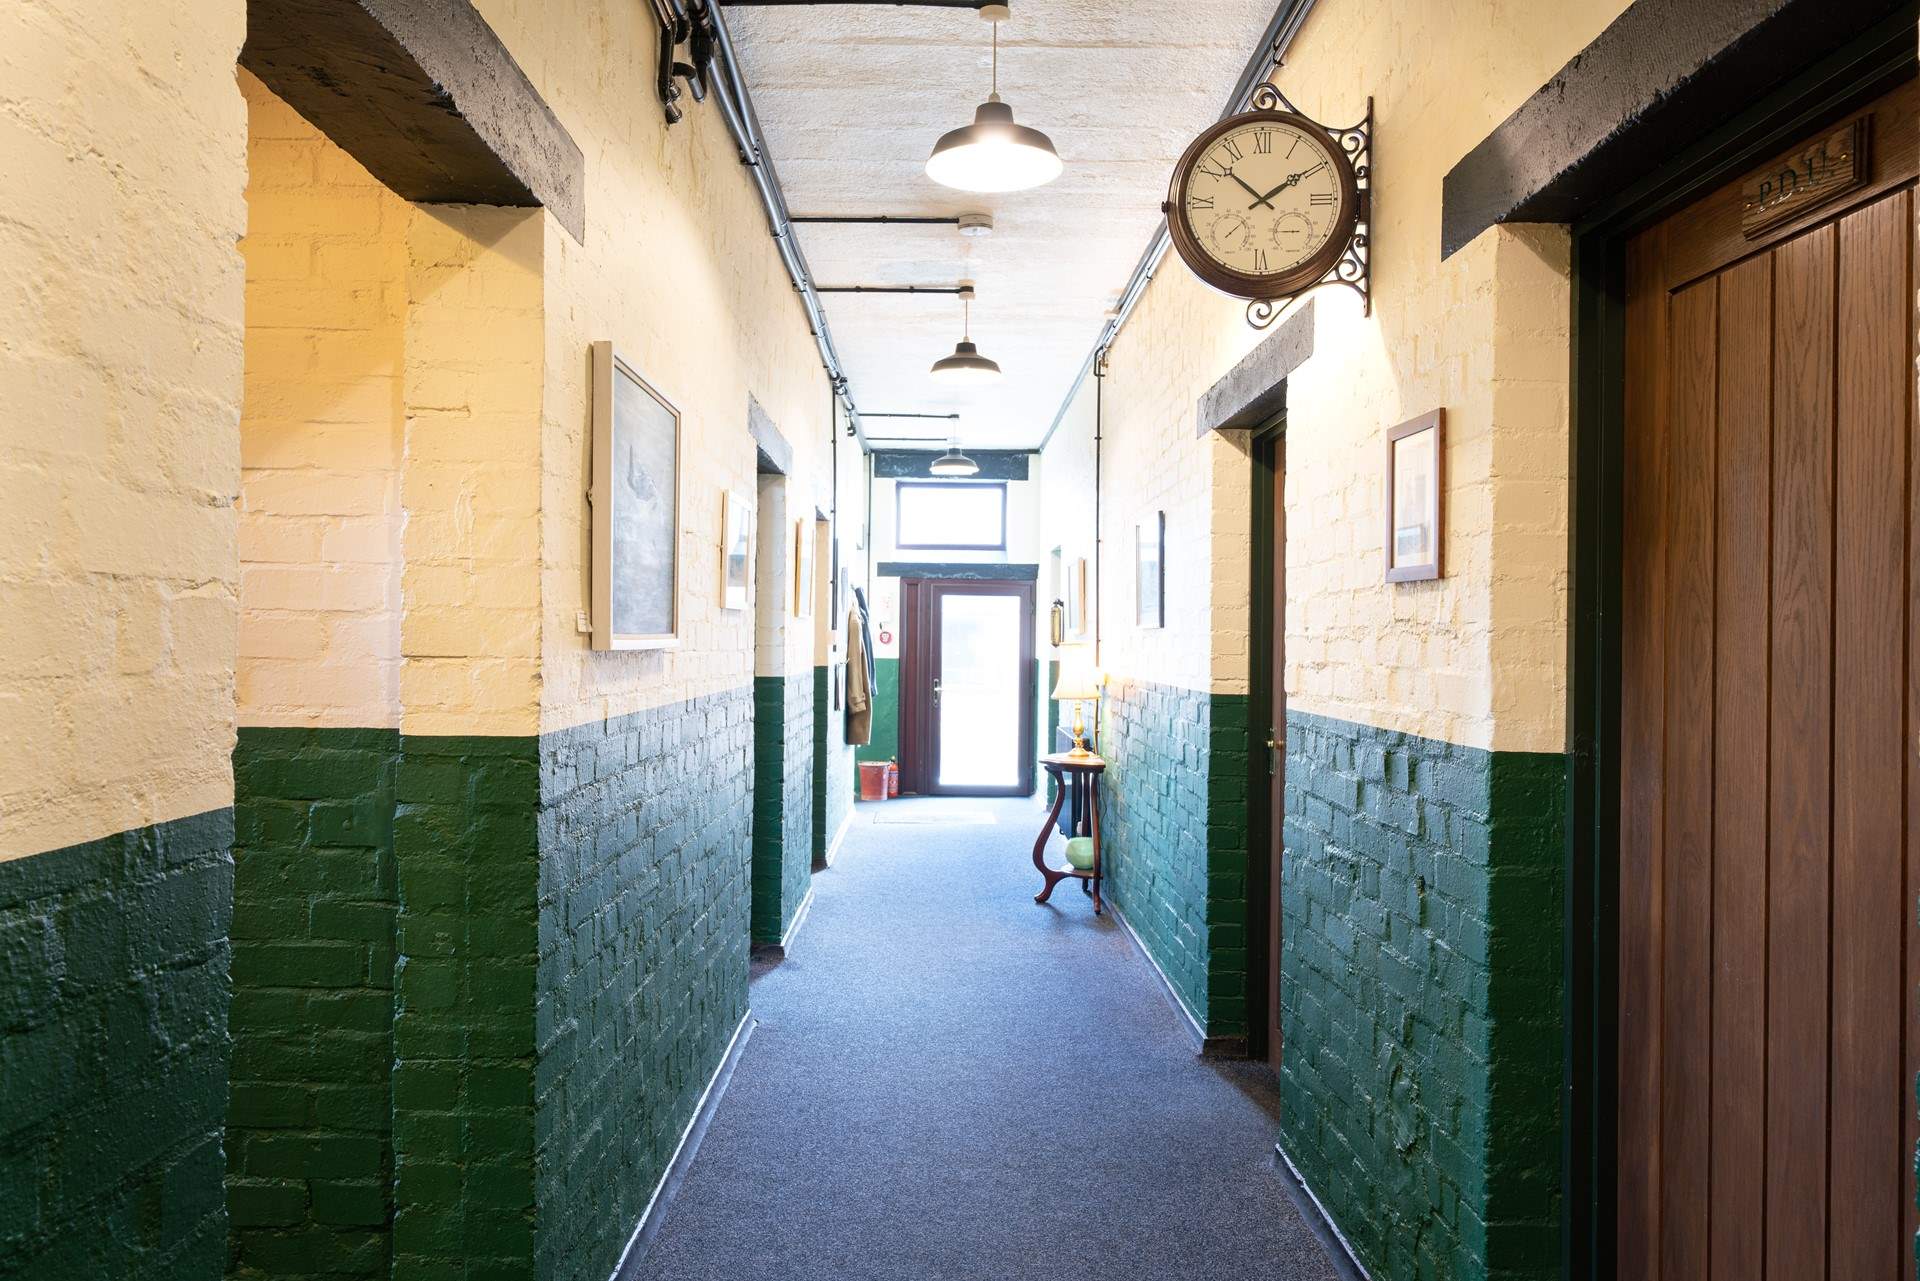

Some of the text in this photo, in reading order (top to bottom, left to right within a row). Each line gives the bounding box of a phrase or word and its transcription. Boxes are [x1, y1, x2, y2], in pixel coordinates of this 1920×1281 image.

[1223, 140, 1243, 163] XI
[1253, 132, 1272, 154] XII
[1192, 196, 1214, 209] IX
[1310, 193, 1332, 206] III
[1253, 248, 1268, 270] VI
